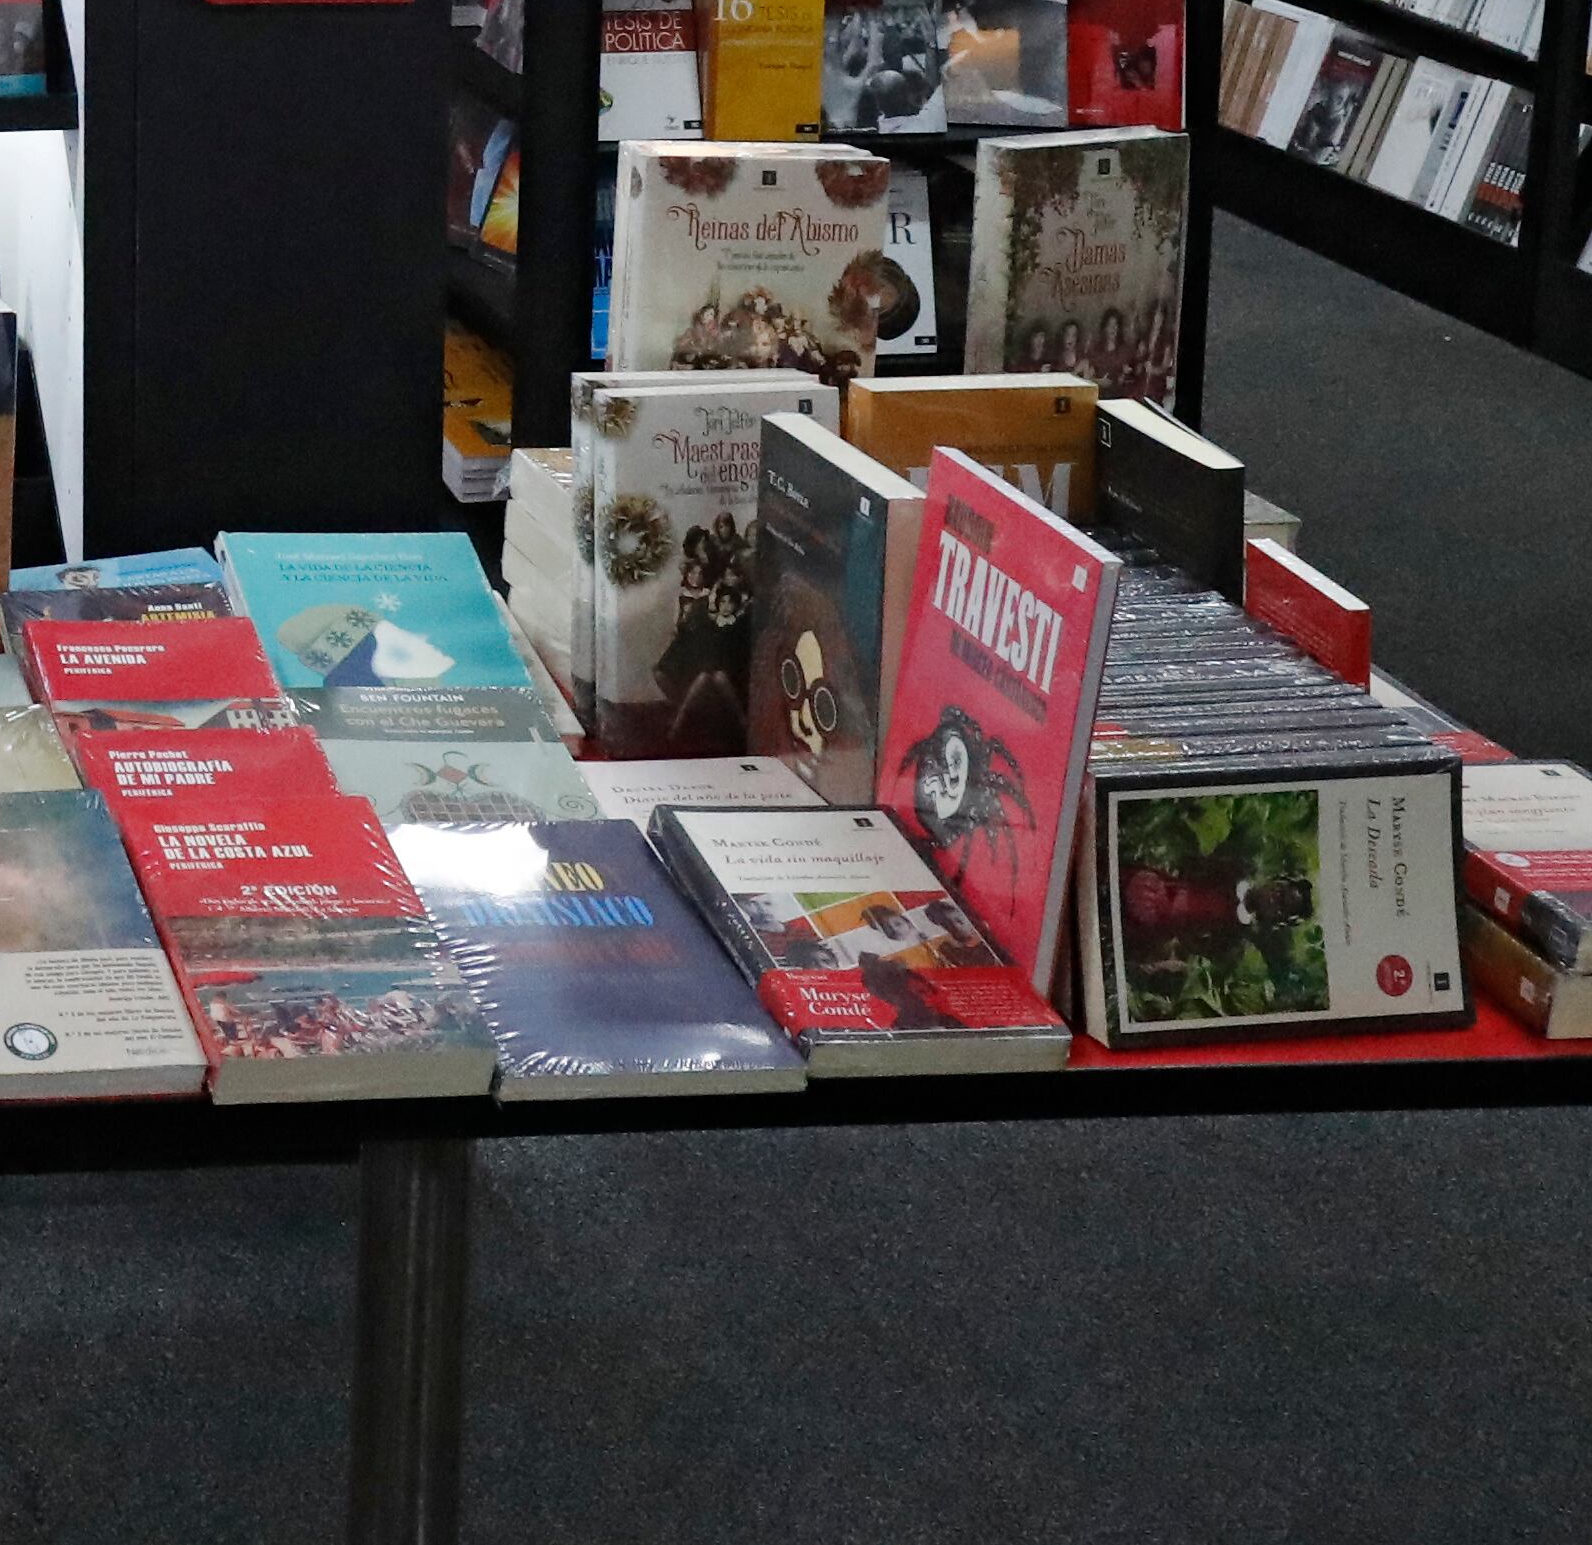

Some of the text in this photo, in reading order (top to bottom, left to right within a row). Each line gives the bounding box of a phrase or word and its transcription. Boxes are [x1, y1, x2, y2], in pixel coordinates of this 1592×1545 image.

[606, 11, 682, 30] TESIS DE
[606, 30, 685, 51] POLÍTICA
[666, 203, 859, 256] Reinas del Abismo
[1057, 226, 1126, 265] Damas
[141, 610, 216, 622] ARTEMISIA
[932, 532, 1063, 694] TRAVESTI
[60, 651, 147, 665] LA AVENIDA
[359, 692, 463, 703] BEN FOUNTAIN
[339, 703, 499, 717] Encuentros fugaces
[344, 716, 504, 729] con el Che Guevara
[113, 758, 233, 774] AUTOBIOGRAFÍA
[117, 772, 217, 786] DE MI PADRE
[159, 834, 247, 847] LA NOVELA
[164, 845, 312, 859] DE LA COSTA AZUL
[1392, 795, 1408, 918] MARYSE CONDÉ
[800, 986, 870, 1005] Maryse
[808, 1001, 872, 1018] Condé
